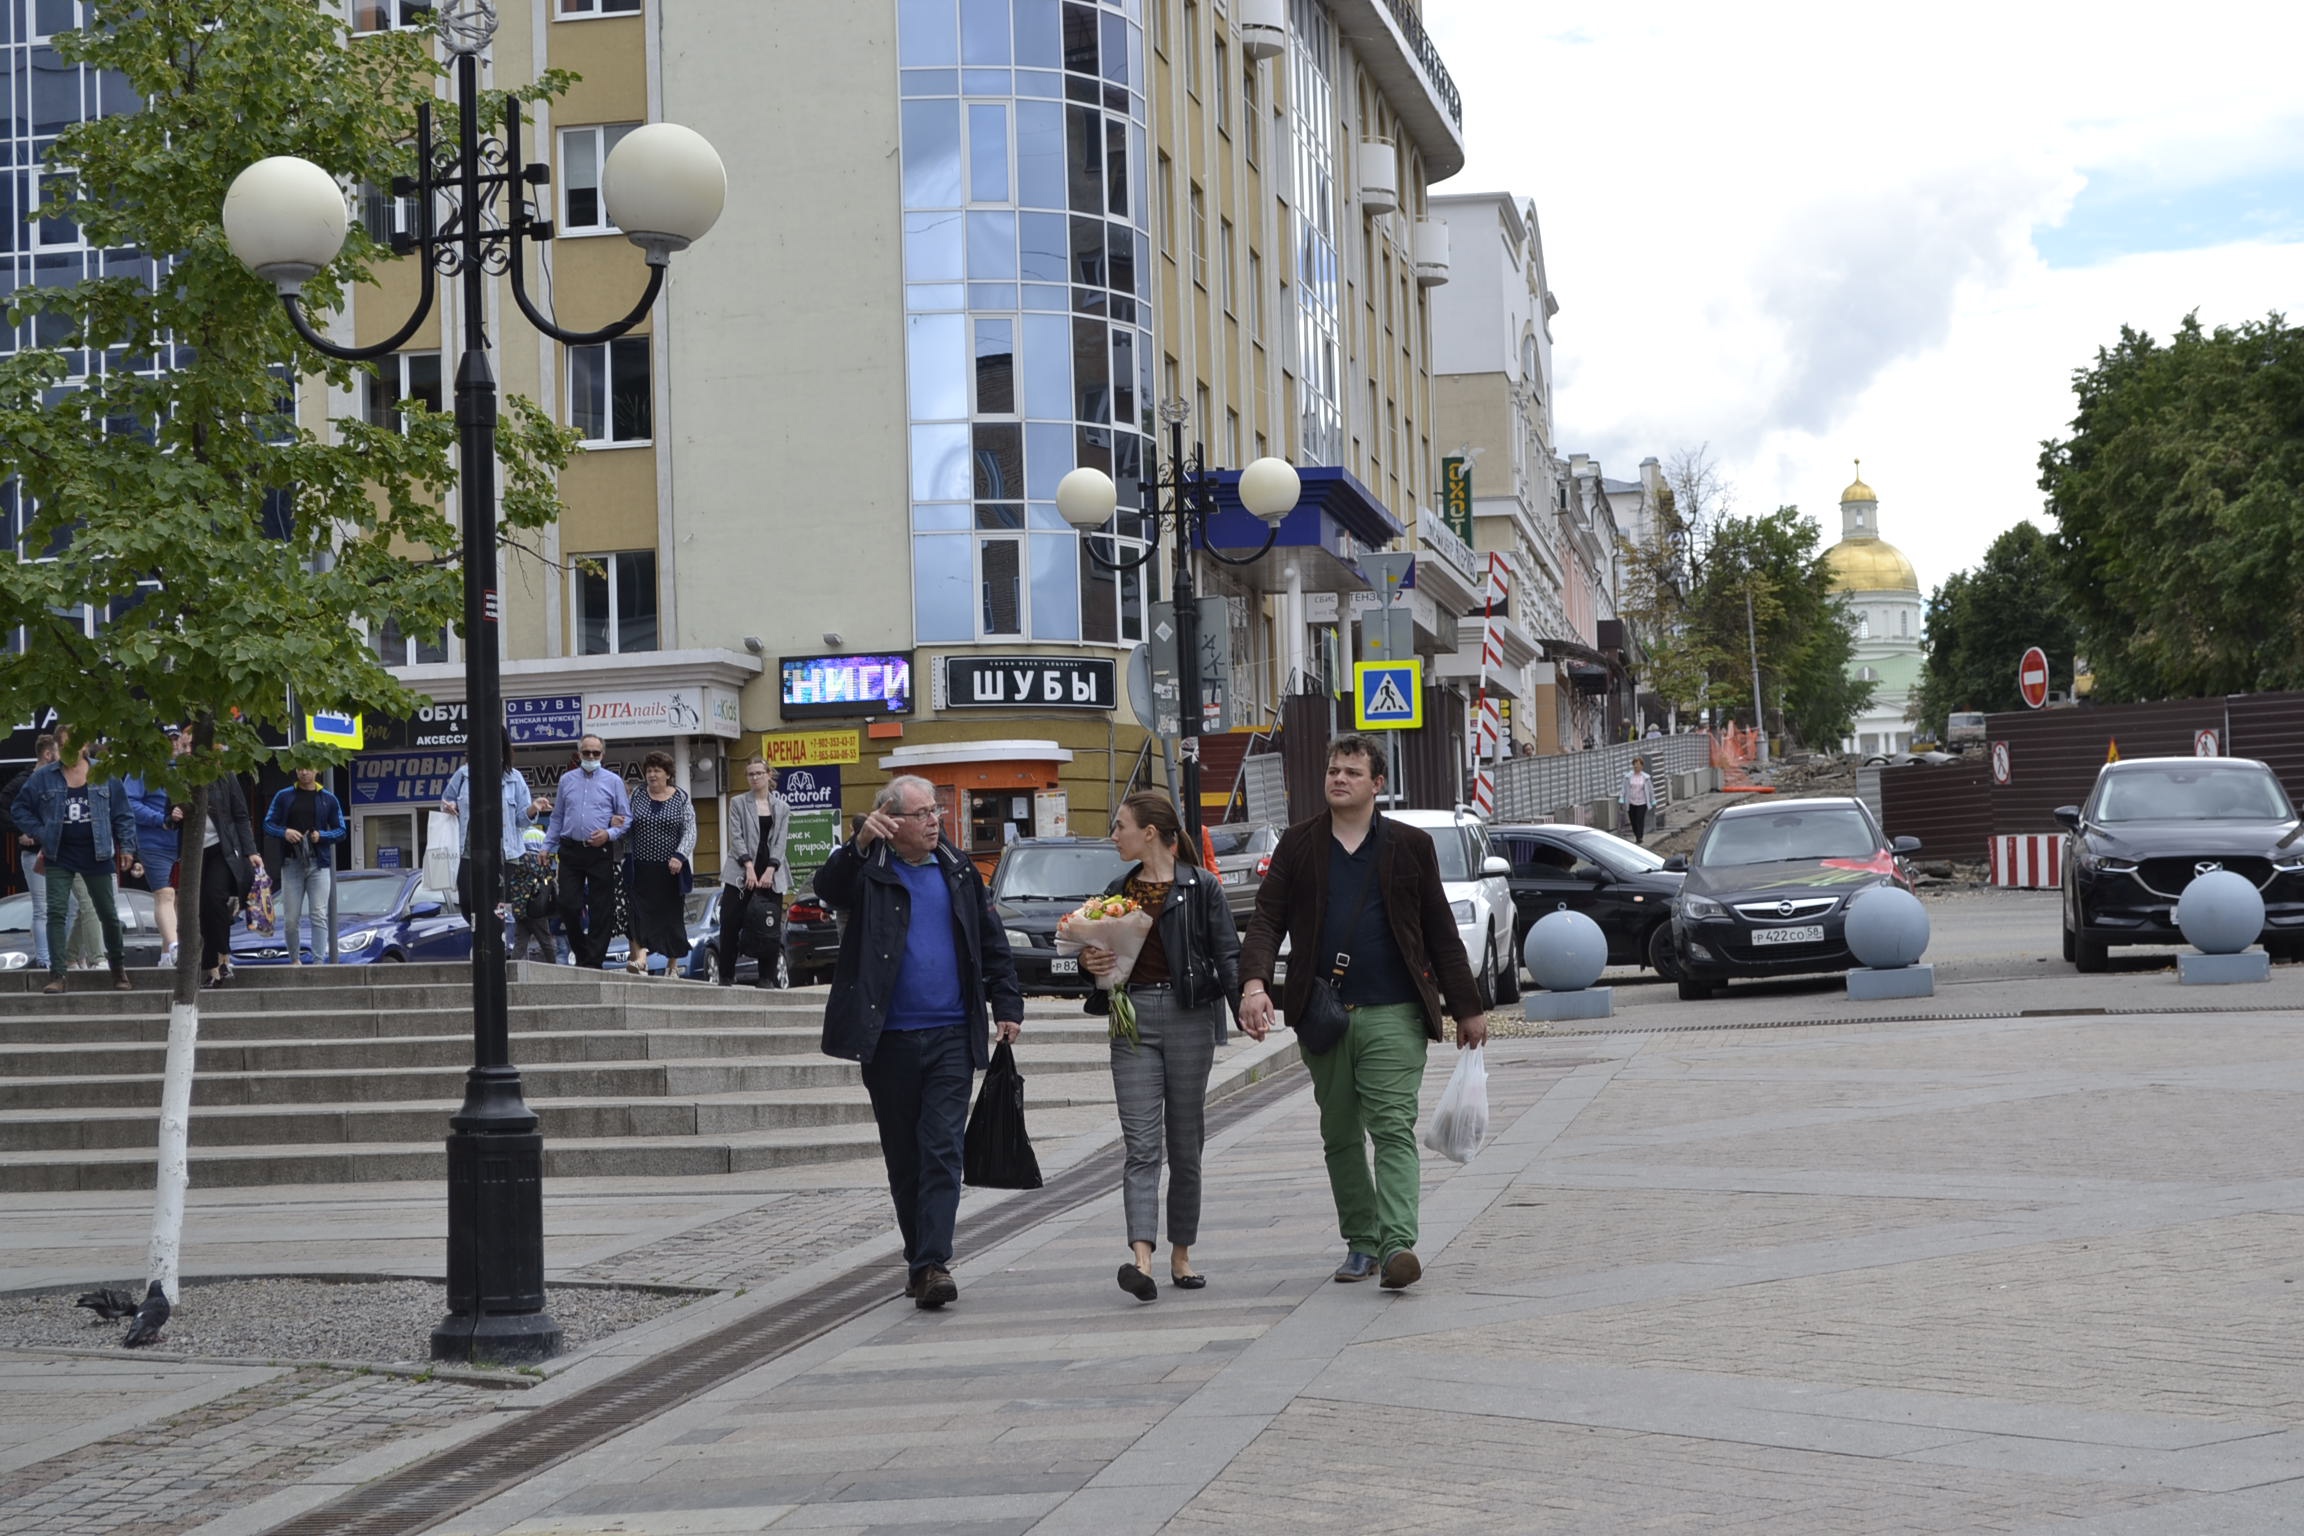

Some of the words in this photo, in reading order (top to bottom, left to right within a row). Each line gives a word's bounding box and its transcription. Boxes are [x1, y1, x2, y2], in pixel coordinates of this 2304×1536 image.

[1448, 463, 1466, 544] ОХОТ
[1350, 592, 1379, 601] ТЕНЗ
[973, 670, 1096, 702] ШУБЫ
[507, 699, 580, 712] ОБУВЬ
[449, 722, 459, 732] &
[509, 717, 541, 725] ЖЕНСКАЯ
[416, 734, 468, 746] АКСЕССУ
[767, 739, 807, 764] АРЕНДА
[396, 778, 450, 799] ЦЕН
[772, 786, 832, 803] Doctoroff
[794, 841, 831, 856] природе
